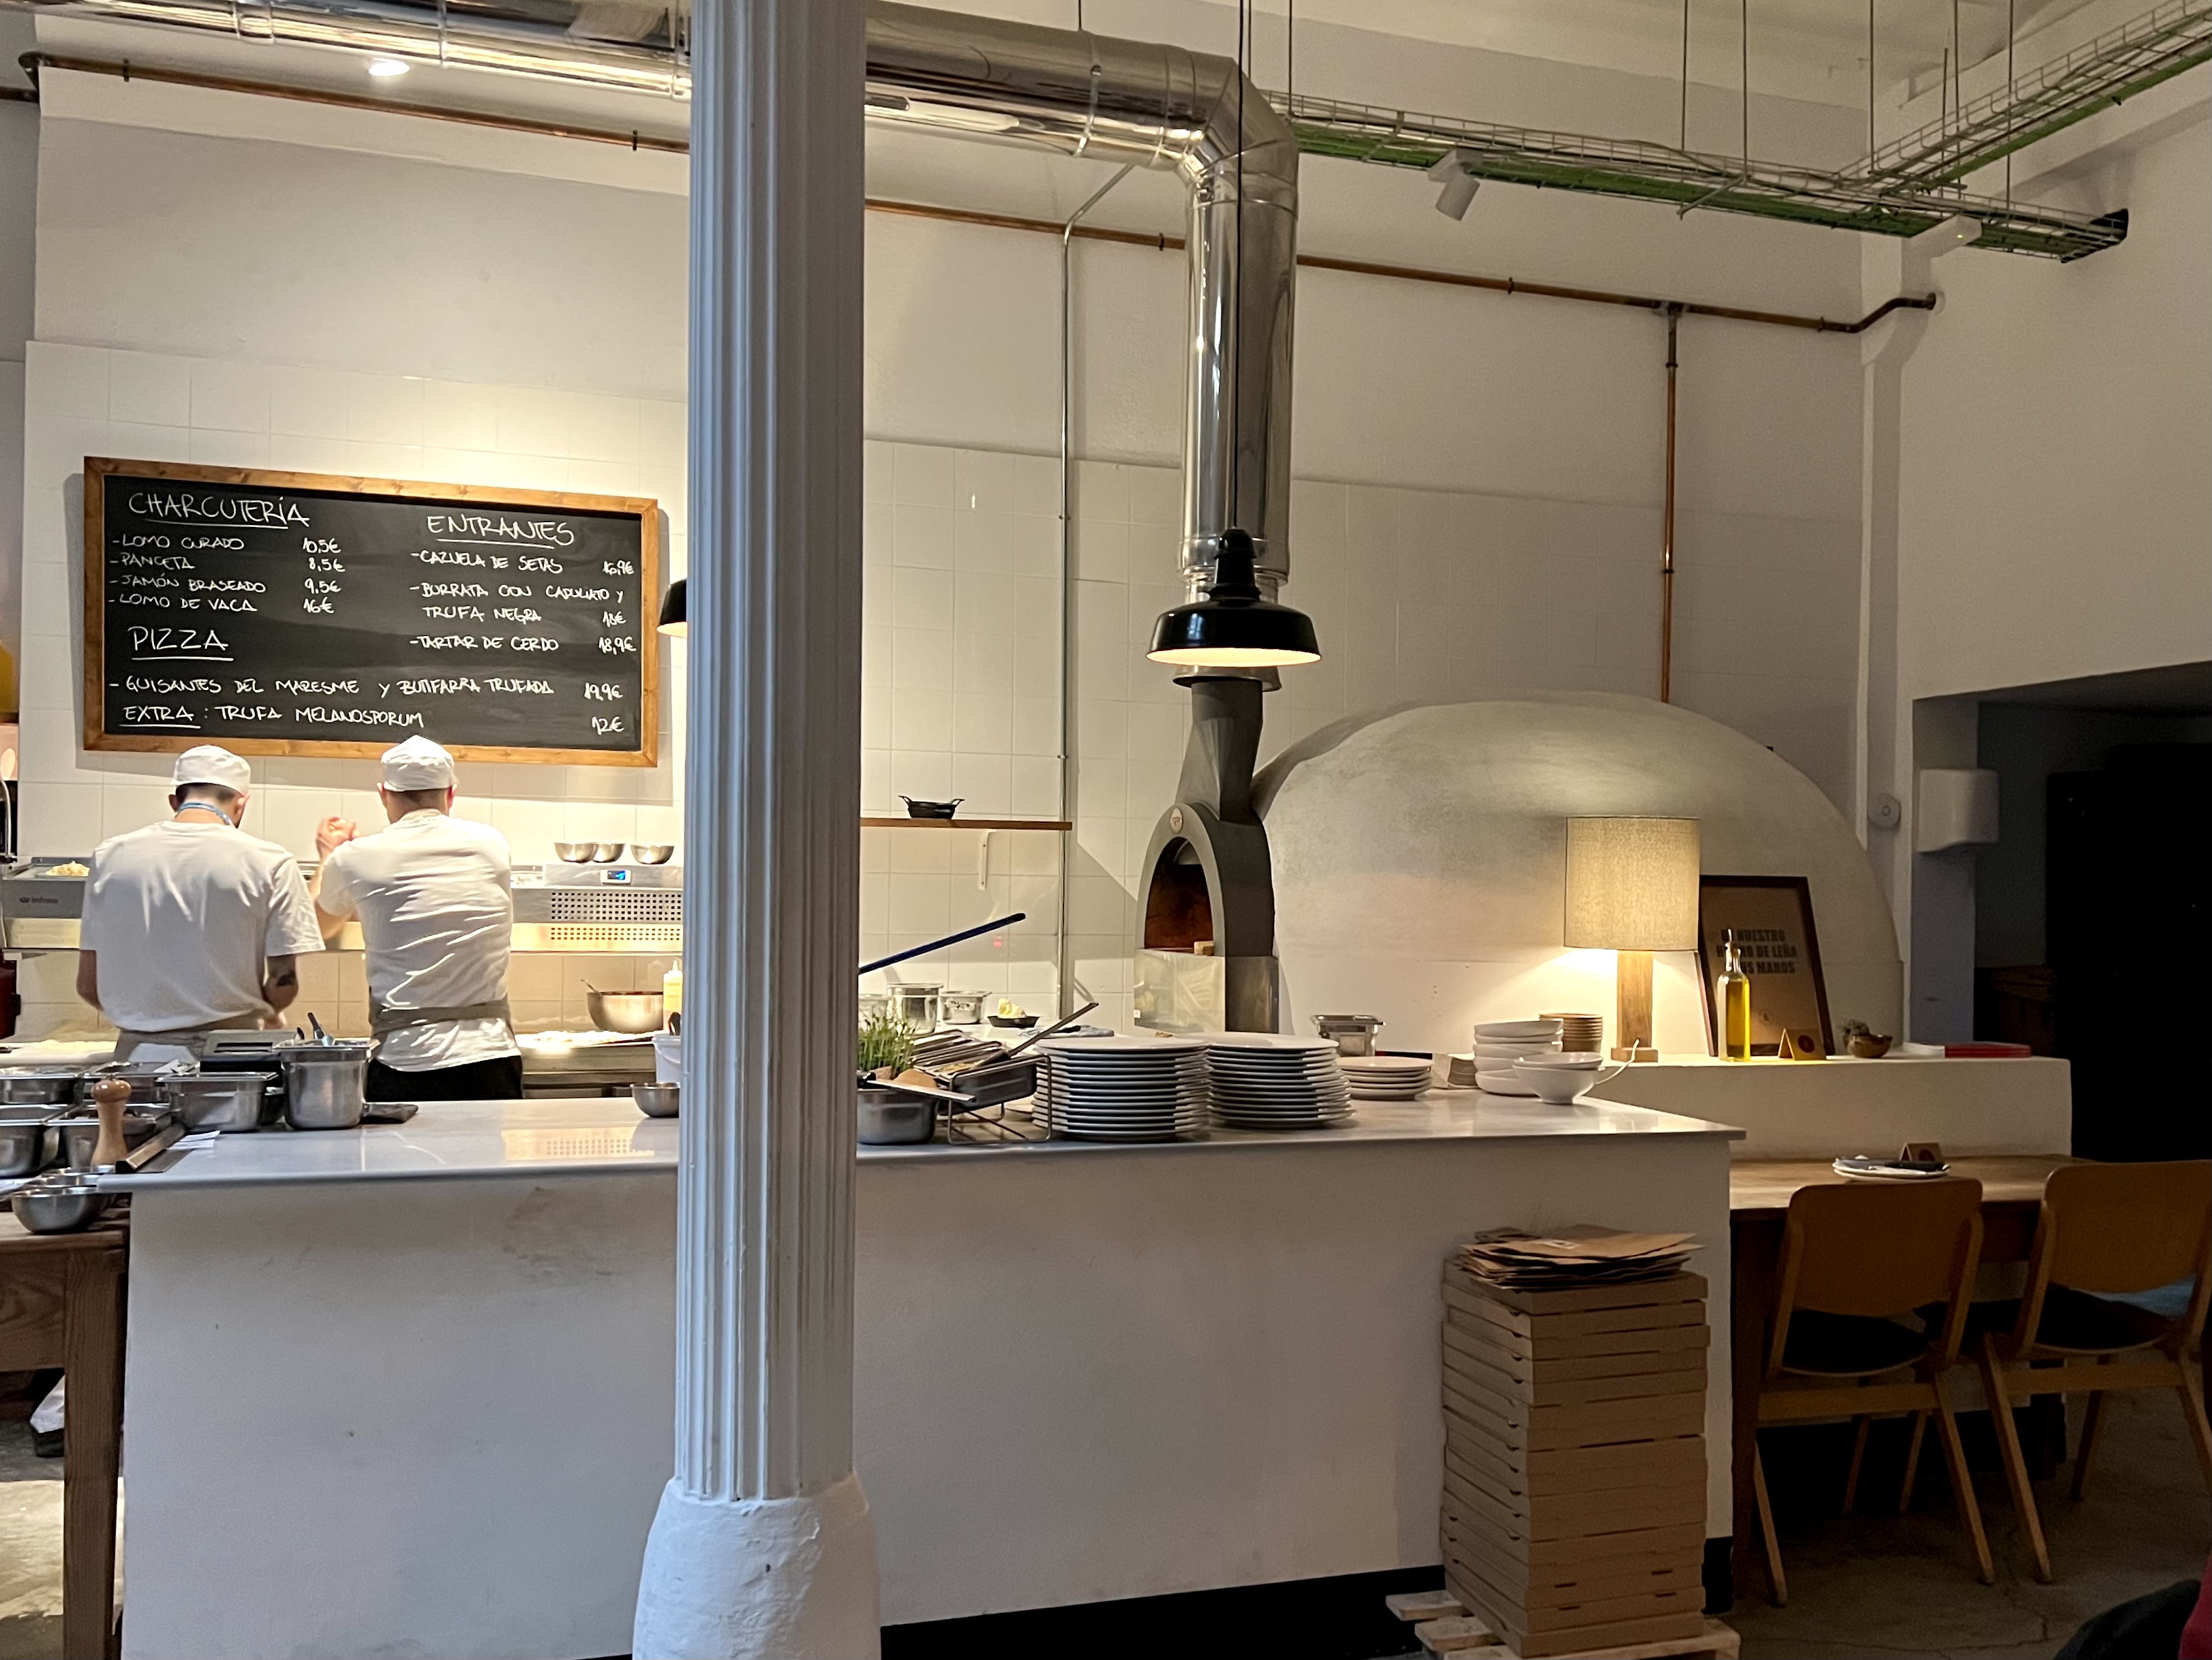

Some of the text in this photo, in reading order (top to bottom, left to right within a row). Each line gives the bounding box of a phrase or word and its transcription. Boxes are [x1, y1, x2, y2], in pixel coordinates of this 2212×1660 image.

[129, 492, 309, 527] CHARCUTERÍA
[427, 514, 575, 545] ENTRANTES
[181, 537, 245, 550] CURADO
[489, 556, 509, 569] DE
[518, 555, 563, 574] SETAS
[187, 579, 267, 593] BRASEADO
[498, 584, 532, 597] CON
[180, 597, 201, 609] DE
[207, 598, 258, 612] VACA
[303, 597, 335, 614] 16€
[421, 605, 542, 625] TRUFA NEGRA
[127, 626, 229, 651] PIZZA
[481, 636, 504, 650] DE
[510, 636, 560, 652] CERDO
[234, 679, 264, 693] DEL
[275, 679, 360, 696] MARESME
[483, 678, 555, 694] TRUFADA
[213, 705, 283, 721] TRUFA
[295, 706, 425, 728] MELANOSPORUM
[592, 716, 625, 736] 12€
[1736, 929, 1785, 942] NUESTRO
[1756, 946, 1770, 957] DE
[1772, 944, 1798, 957] LEÑA
[1756, 961, 1795, 974] MANOS
